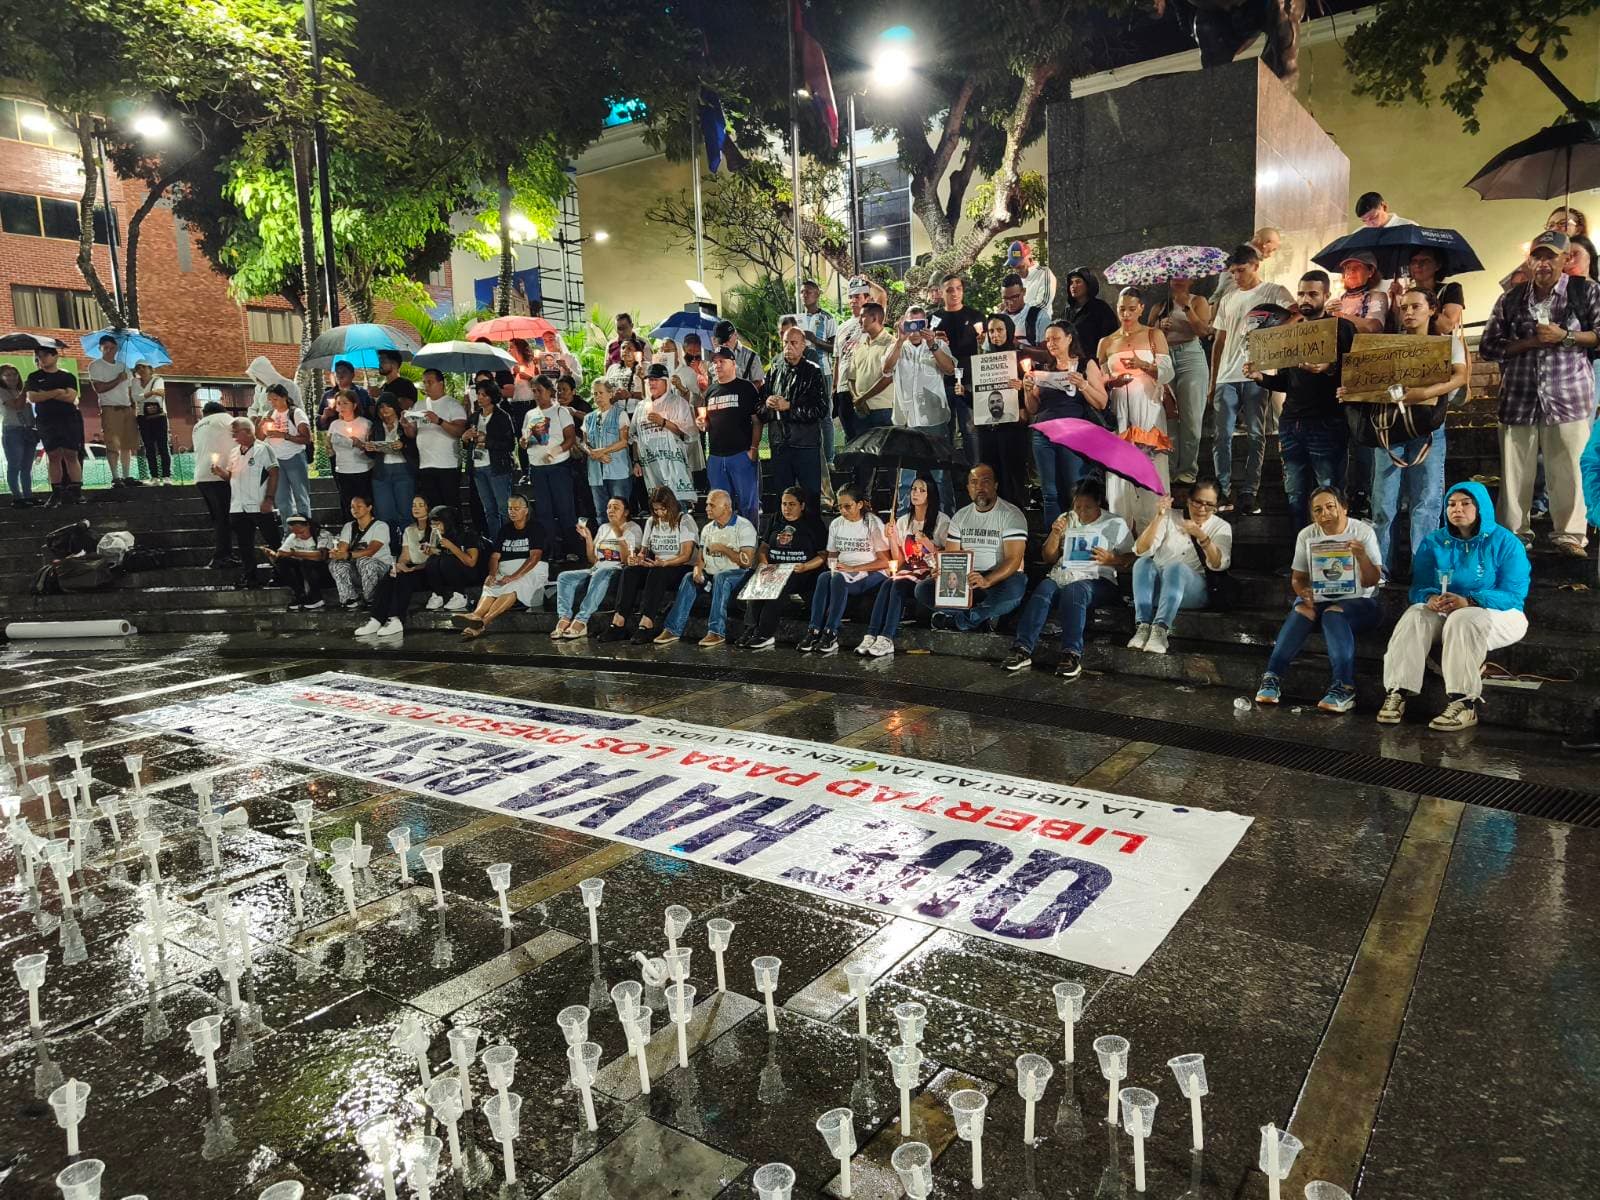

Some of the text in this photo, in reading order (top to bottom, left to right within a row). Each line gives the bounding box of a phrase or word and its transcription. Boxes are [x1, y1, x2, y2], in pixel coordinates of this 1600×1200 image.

[981, 355, 1008, 364] JOSNAR
[981, 362, 1008, 371] BADUEL
[436, 713, 590, 746] PRESOS
[651, 726, 719, 744] VIDAS
[583, 737, 677, 761] LOS
[722, 737, 801, 757] SALVA
[678, 750, 821, 787] PARA
[931, 775, 1089, 810] LIBERTAD
[496, 762, 834, 864] HAYA
[825, 778, 1149, 854] LIBERTAD
[1101, 804, 1146, 819] LA
